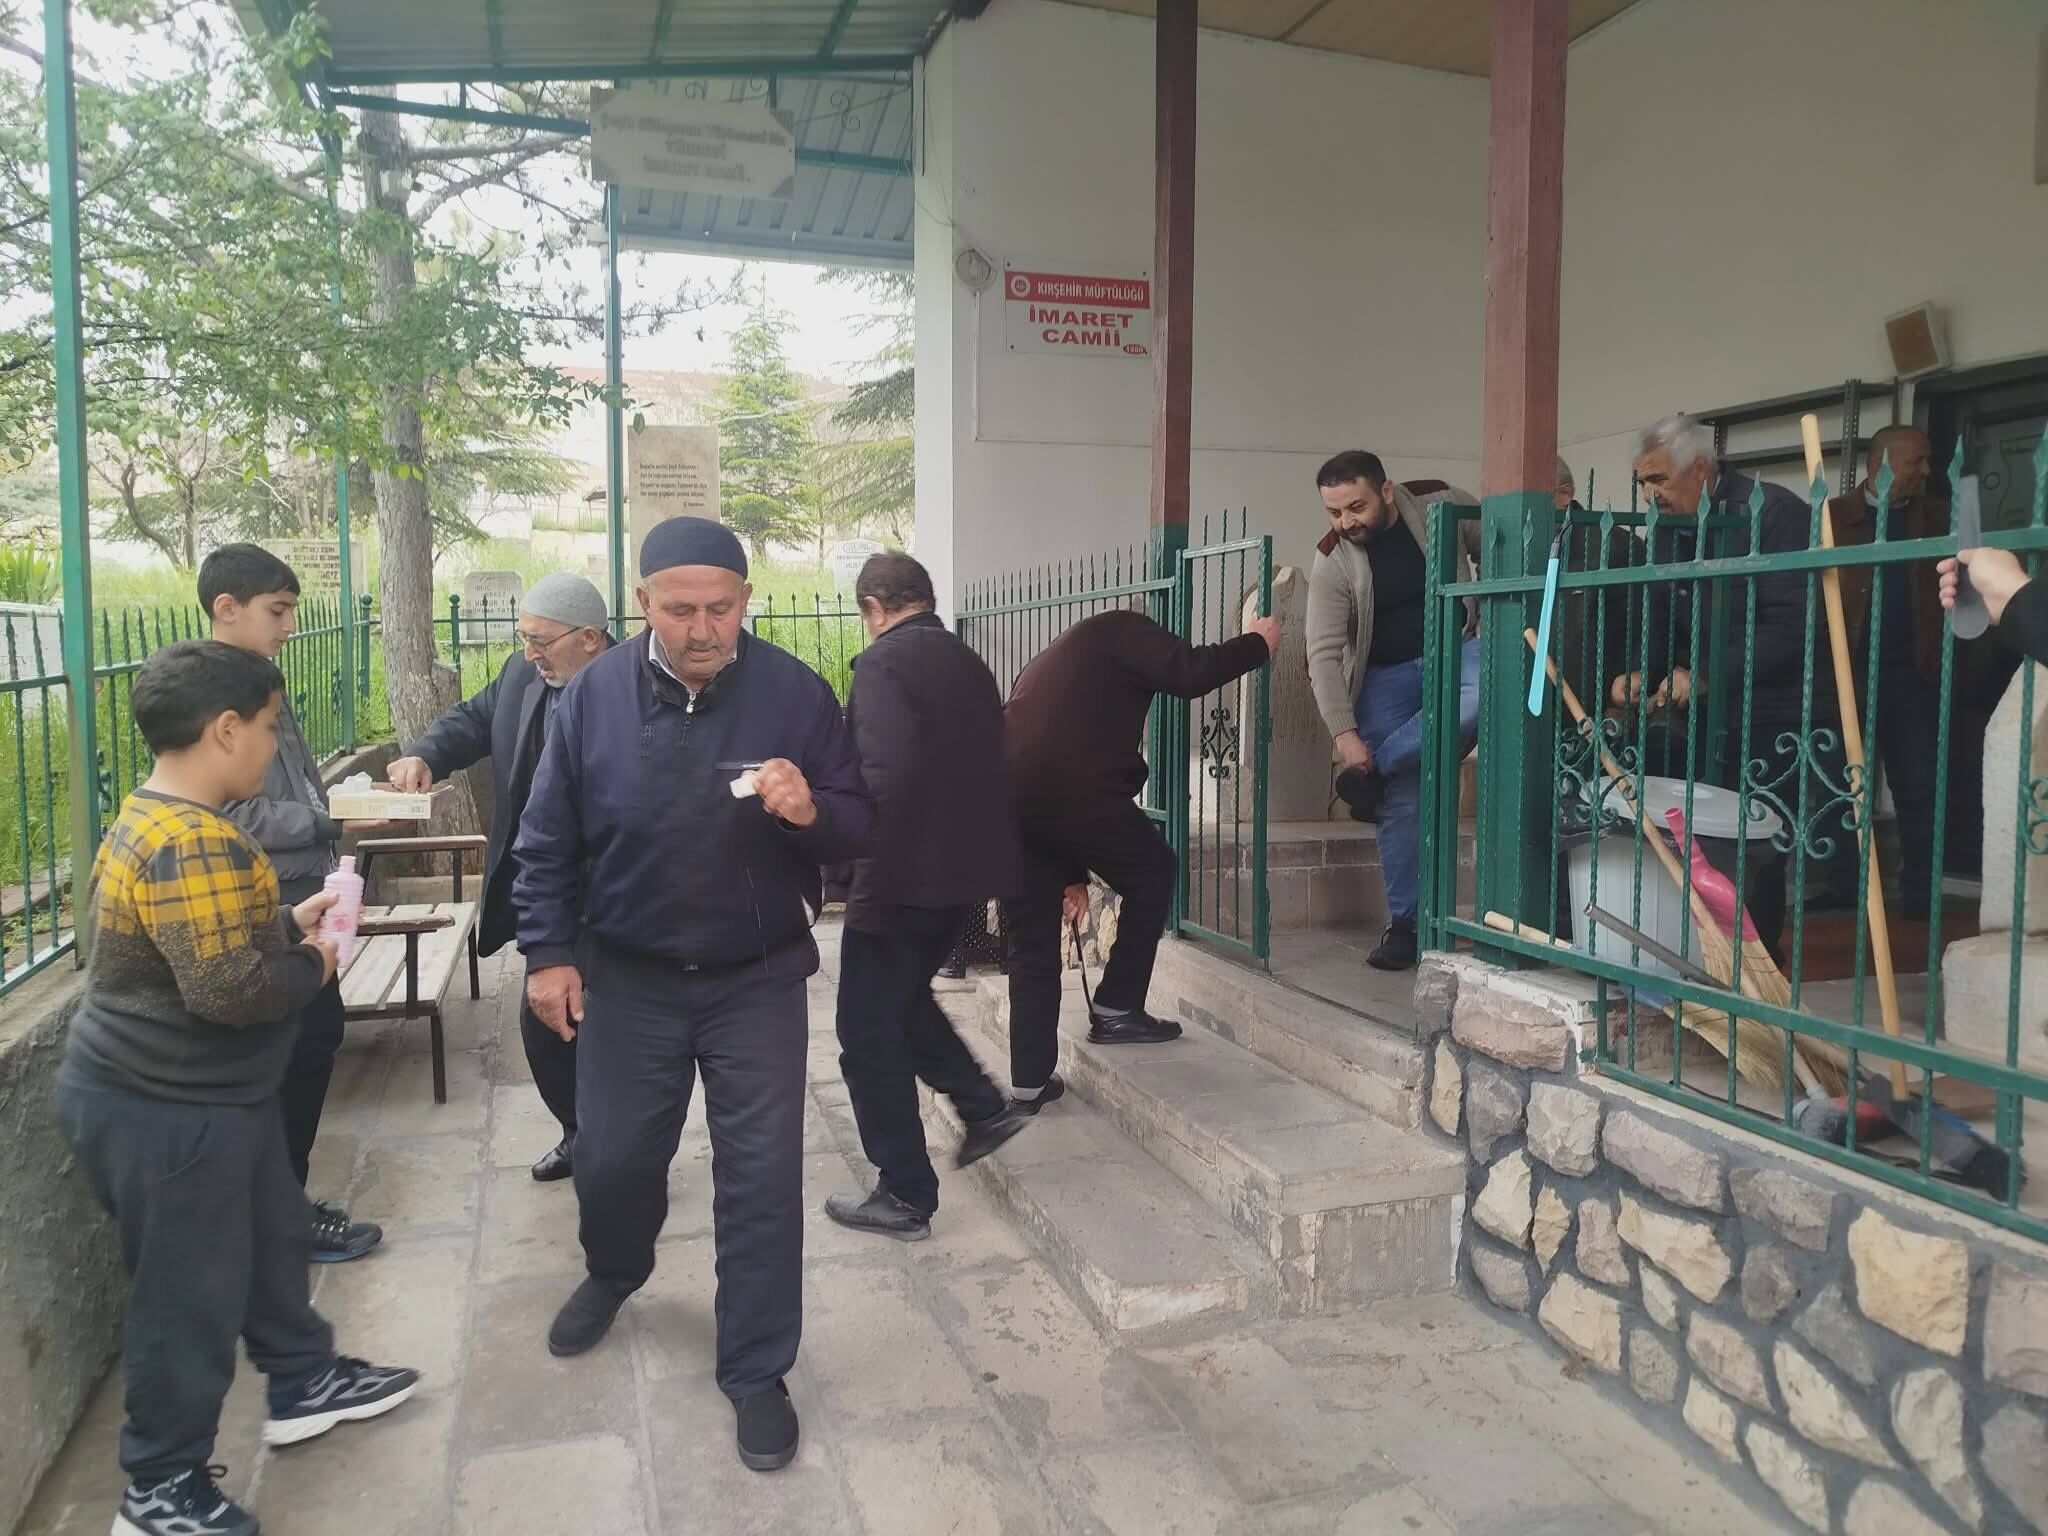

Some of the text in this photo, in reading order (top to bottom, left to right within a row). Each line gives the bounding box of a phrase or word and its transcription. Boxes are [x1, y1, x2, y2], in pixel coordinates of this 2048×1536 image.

[1037, 280, 1144, 302] KIRŞEHİR MÜFTÜLÜĞÜ
[1029, 304, 1134, 329] İMARET
[1042, 328, 1121, 347] CAMİİ
